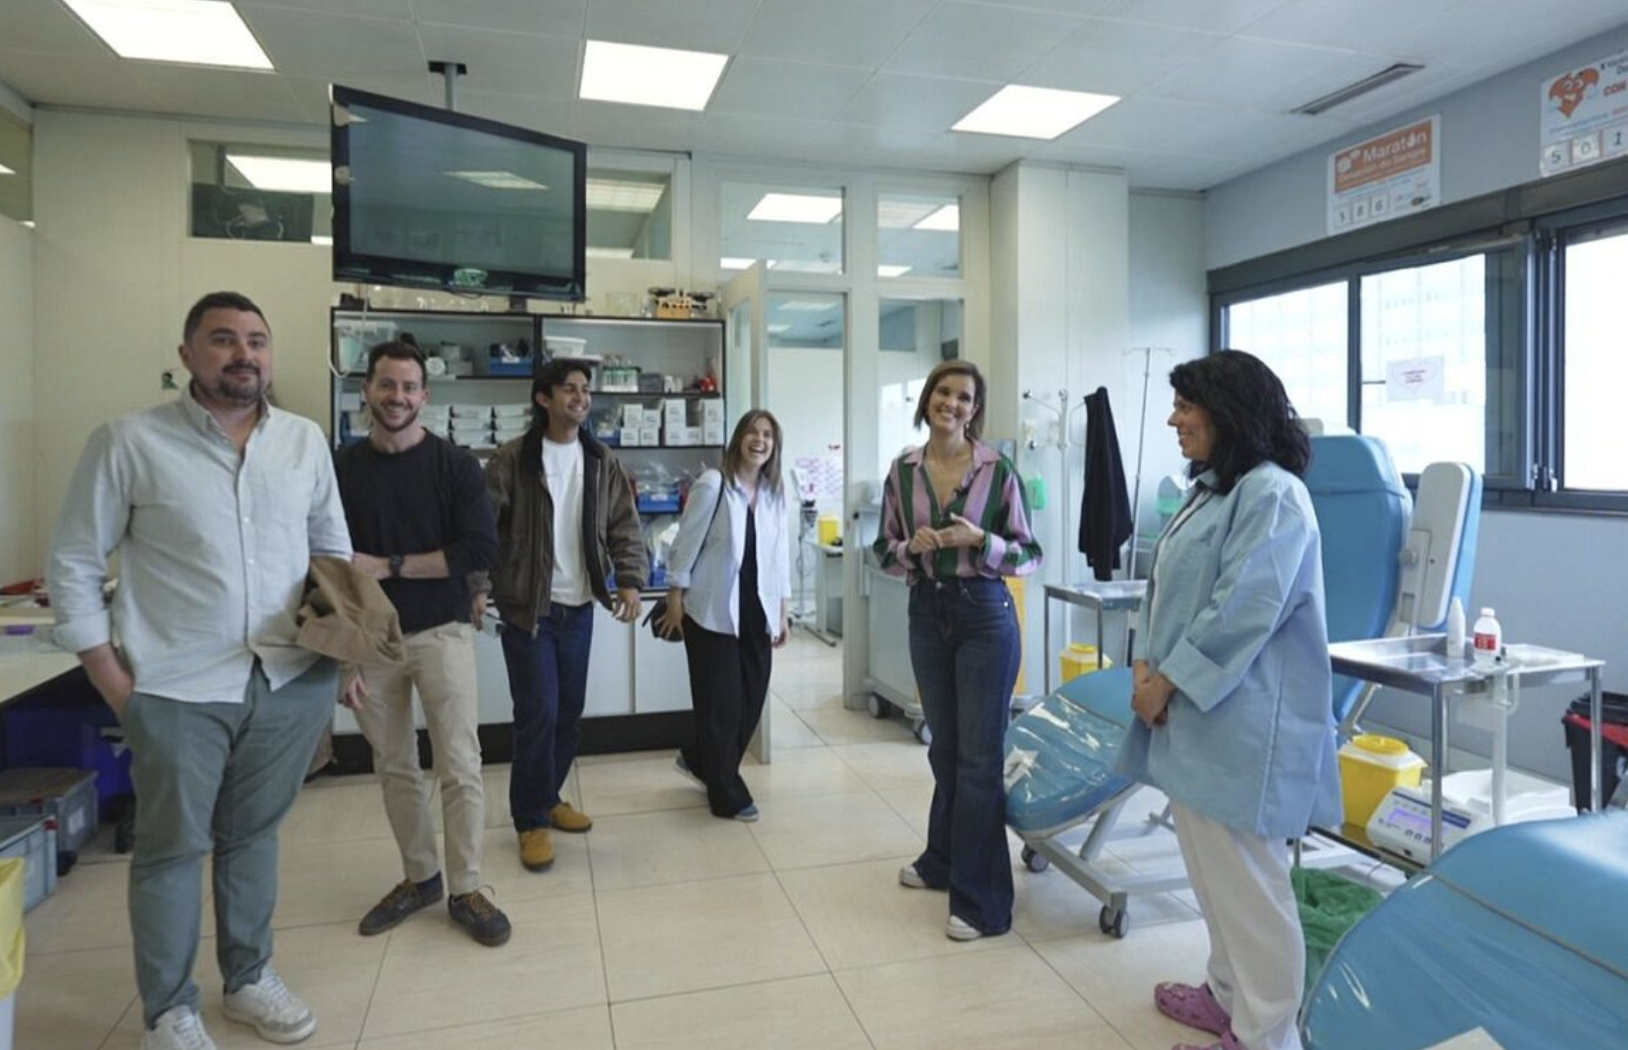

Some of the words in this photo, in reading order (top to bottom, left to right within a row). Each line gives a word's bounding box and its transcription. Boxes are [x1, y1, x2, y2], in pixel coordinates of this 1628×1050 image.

[1363, 132, 1427, 164] Maratón
[1551, 149, 1561, 165] 5
[1581, 141, 1592, 155] 0
[1613, 131, 1622, 146] 1
